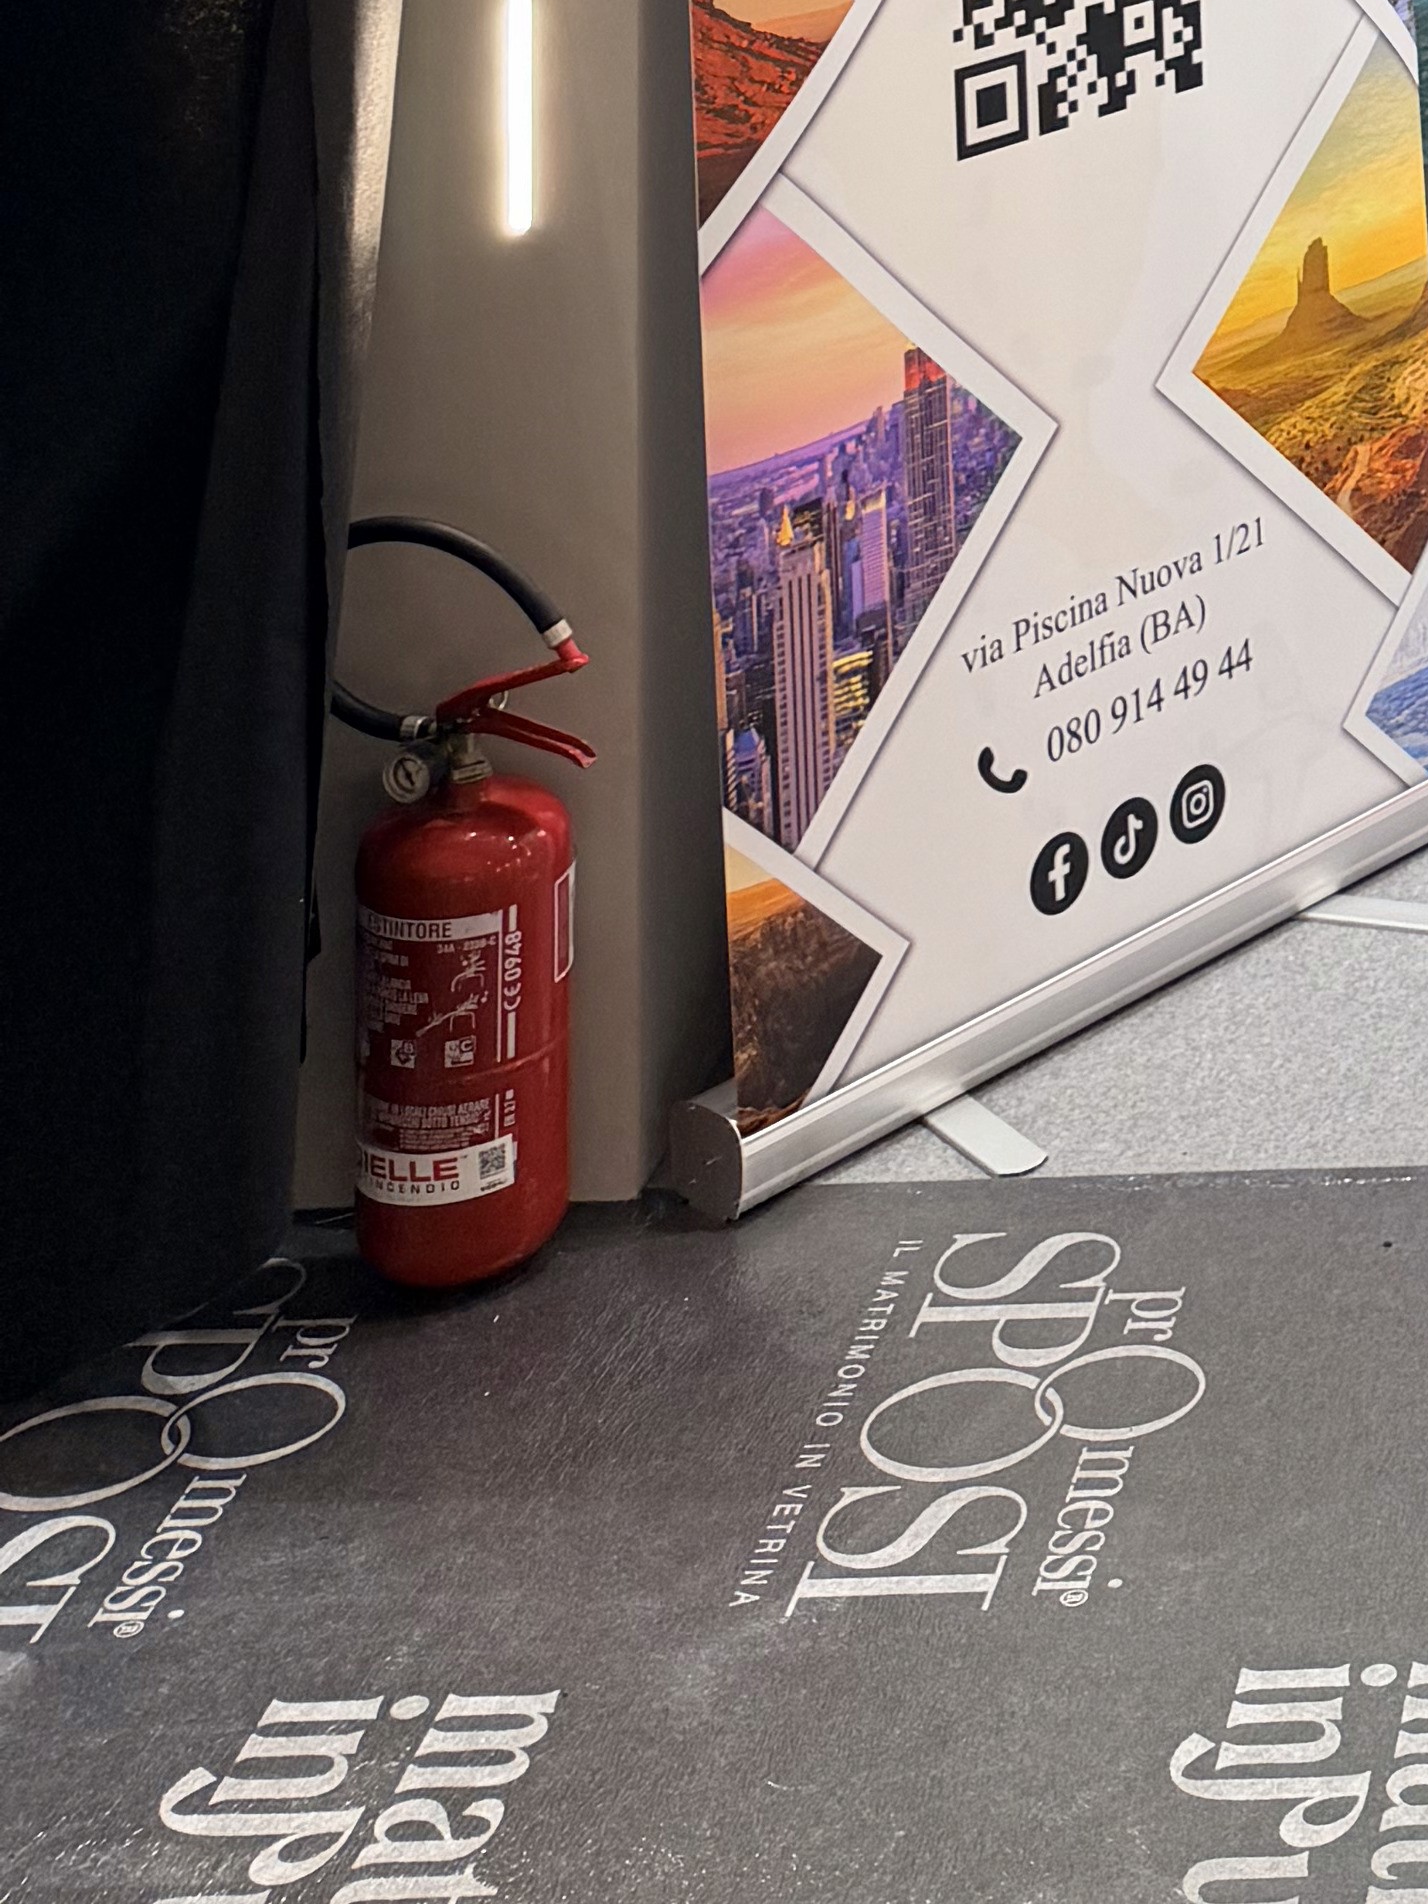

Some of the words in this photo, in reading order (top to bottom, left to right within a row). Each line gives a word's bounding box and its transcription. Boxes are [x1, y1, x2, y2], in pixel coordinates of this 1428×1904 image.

[960, 631, 1005, 674] via
[1012, 591, 1108, 655] Piscina
[1115, 549, 1202, 606] Nuova
[1213, 515, 1266, 565] 1/21
[1033, 629, 1131, 698] Adelfia
[1139, 594, 1207, 655] (BA)
[1047, 708, 1101, 764] 080
[1110, 678, 1164, 735] 914
[1173, 656, 1208, 705] 49
[1217, 638, 1254, 684] 44
[893, 1239, 923, 1258] IL
[815, 1271, 909, 1427] MATRIMONIO
[785, 1232, 1121, 1618] SPOSI
[795, 1443, 832, 1469] IN
[729, 1483, 812, 1607] VETRINA
